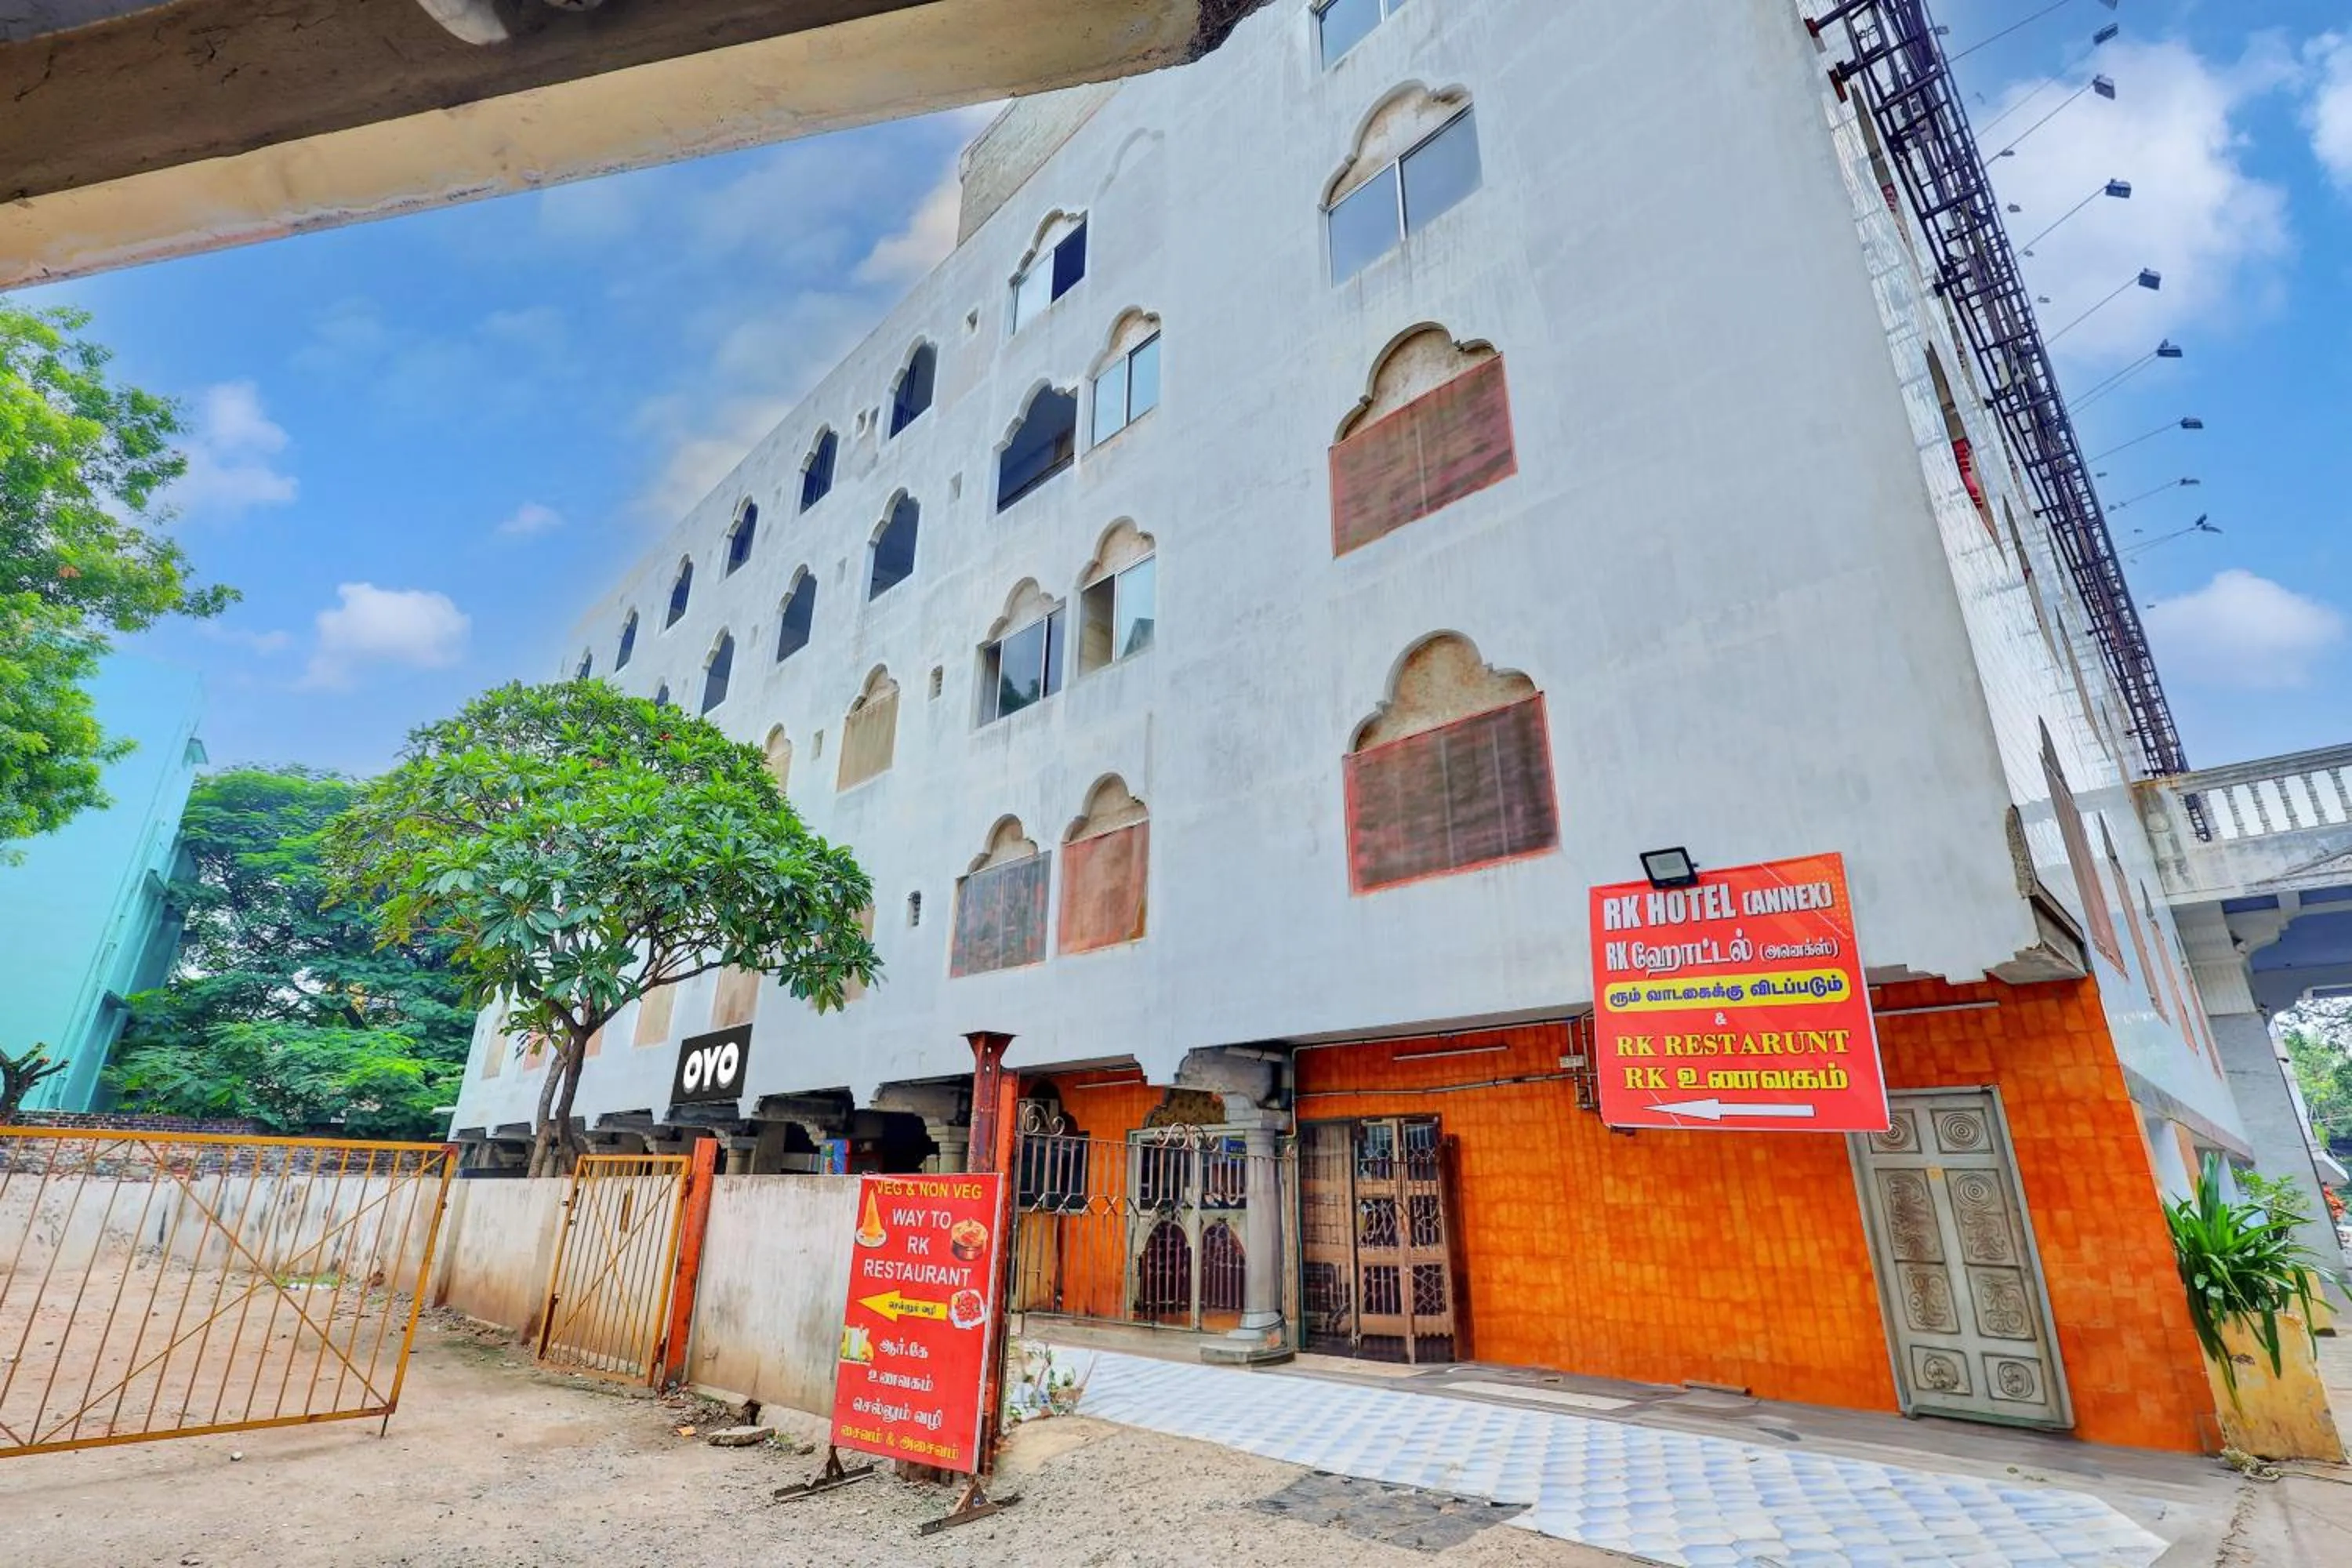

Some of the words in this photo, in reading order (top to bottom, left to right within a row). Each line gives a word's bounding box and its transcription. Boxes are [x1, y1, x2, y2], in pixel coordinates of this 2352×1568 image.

[1603, 895, 1642, 931] RK
[1646, 883, 1737, 926] HOTEL
[1606, 941, 1629, 971] RK
[1610, 987, 1641, 1007] ரூம்
[1646, 982, 1743, 1002] வாடகைக்கு
[1751, 975, 1843, 998] விடப்படும்
[1715, 1011, 1727, 1025] &
[1616, 1035, 1657, 1057] RK
[1664, 1030, 1850, 1056] RESTARUNT
[683, 1042, 739, 1093] OYO
[1623, 1066, 1671, 1090] RK
[1676, 1062, 1849, 1090] உணவகம்
[876, 1181, 902, 1196] VEG
[906, 1182, 915, 1196] &
[920, 1182, 949, 1198] NON
[953, 1184, 982, 1200] VEG
[892, 1208, 926, 1227] WAY
[931, 1210, 953, 1229] TO
[907, 1236, 930, 1255] RK
[863, 1258, 971, 1287] RESTAURANT
[867, 1370, 934, 1392] உணவகம்
[886, 1431, 895, 1446] &
